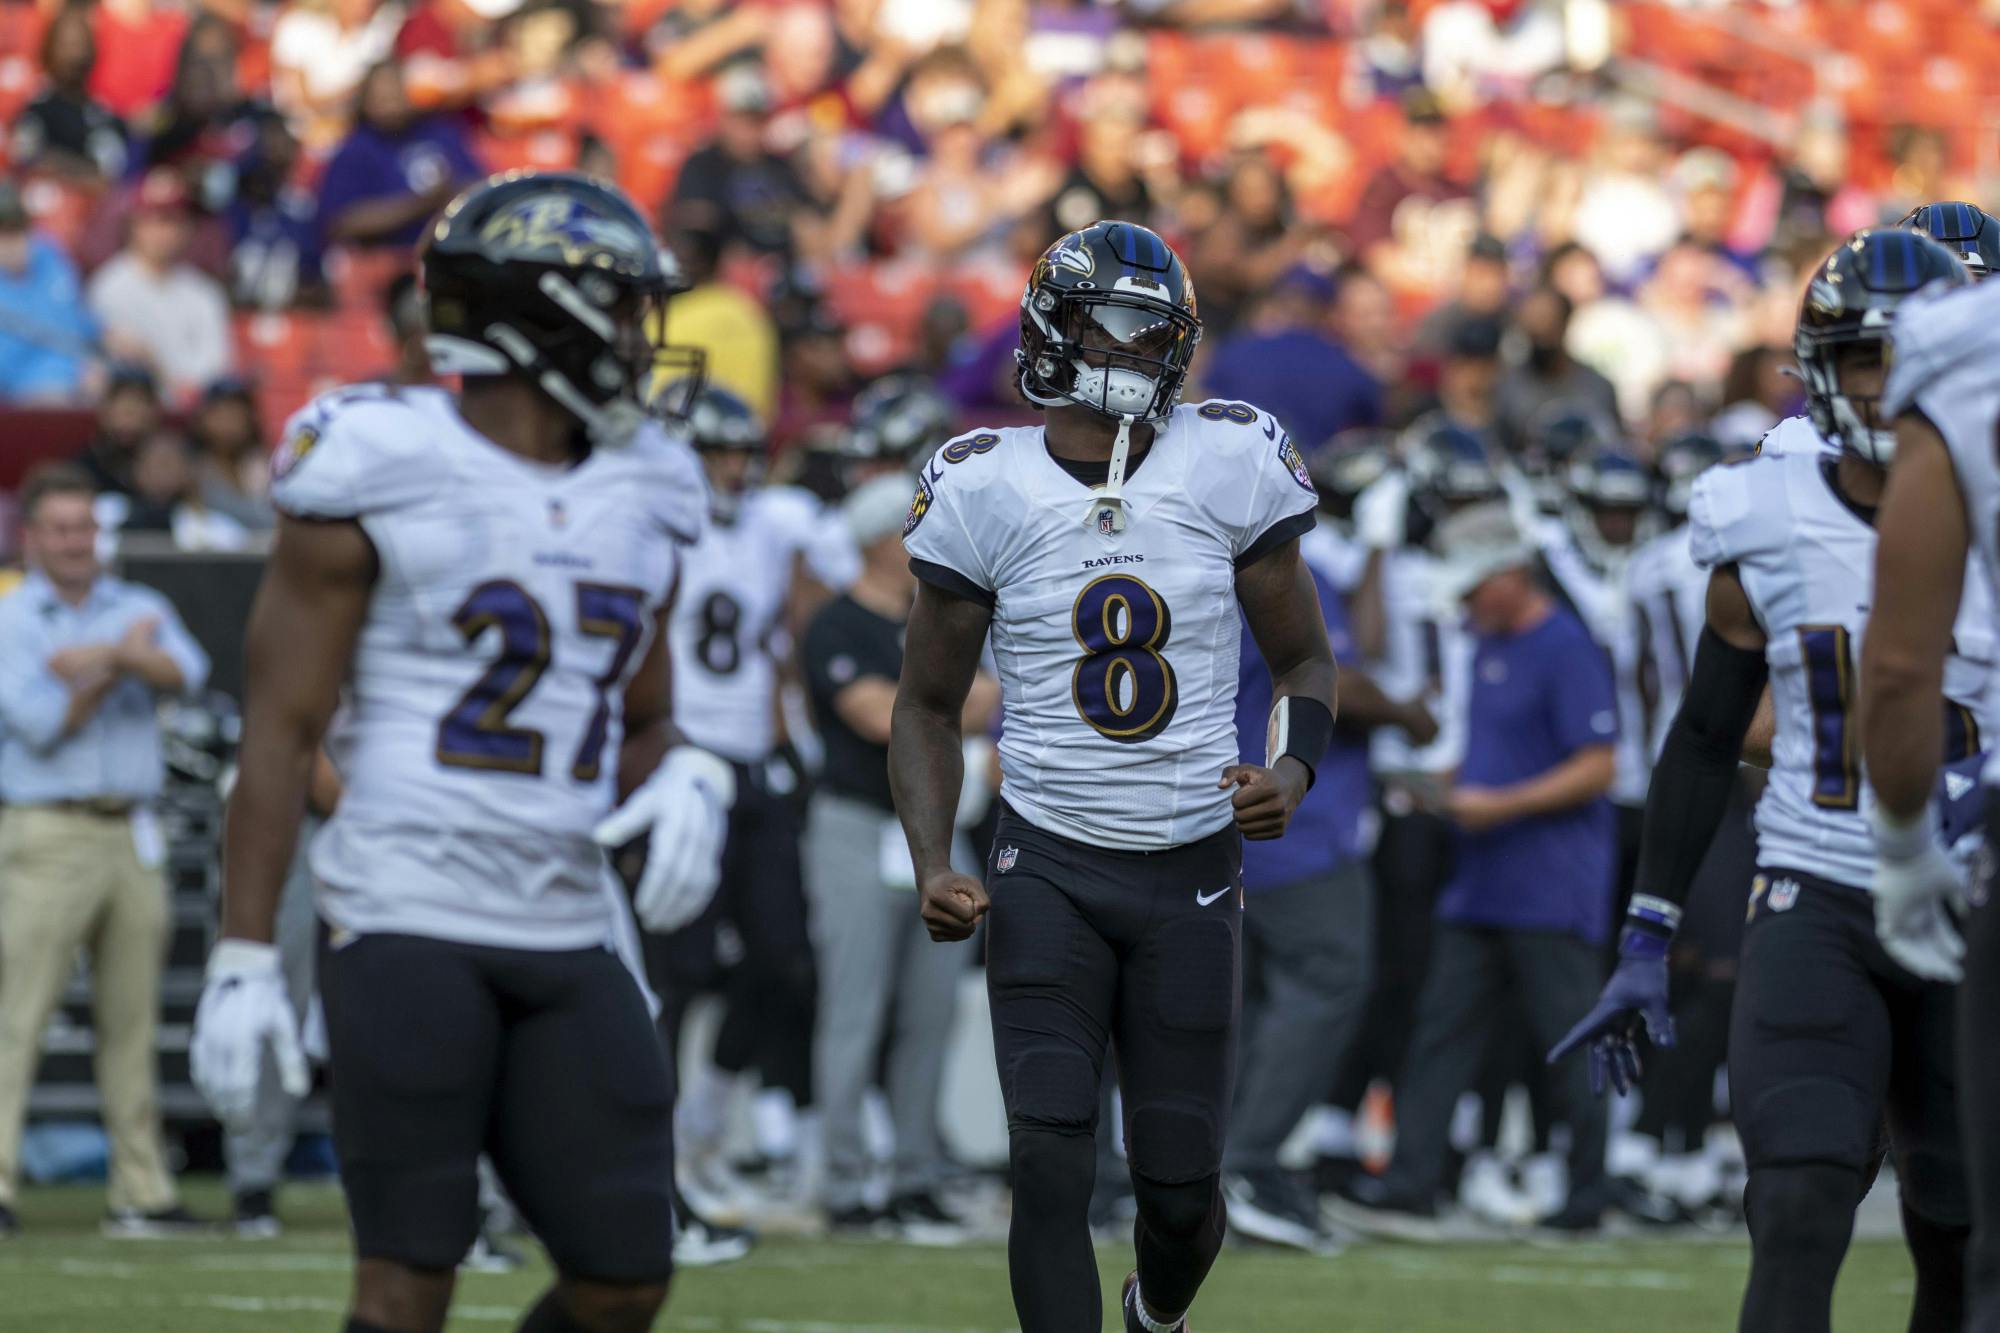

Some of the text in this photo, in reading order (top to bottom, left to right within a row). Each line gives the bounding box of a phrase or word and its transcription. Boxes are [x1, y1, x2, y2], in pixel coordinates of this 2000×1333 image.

[1197, 402, 1257, 426] 8
[942, 433, 1001, 464] 8
[1081, 554, 1144, 569] RAVENS
[697, 588, 742, 677] 8
[1072, 574, 1179, 744] 8
[437, 578, 647, 783] 27
